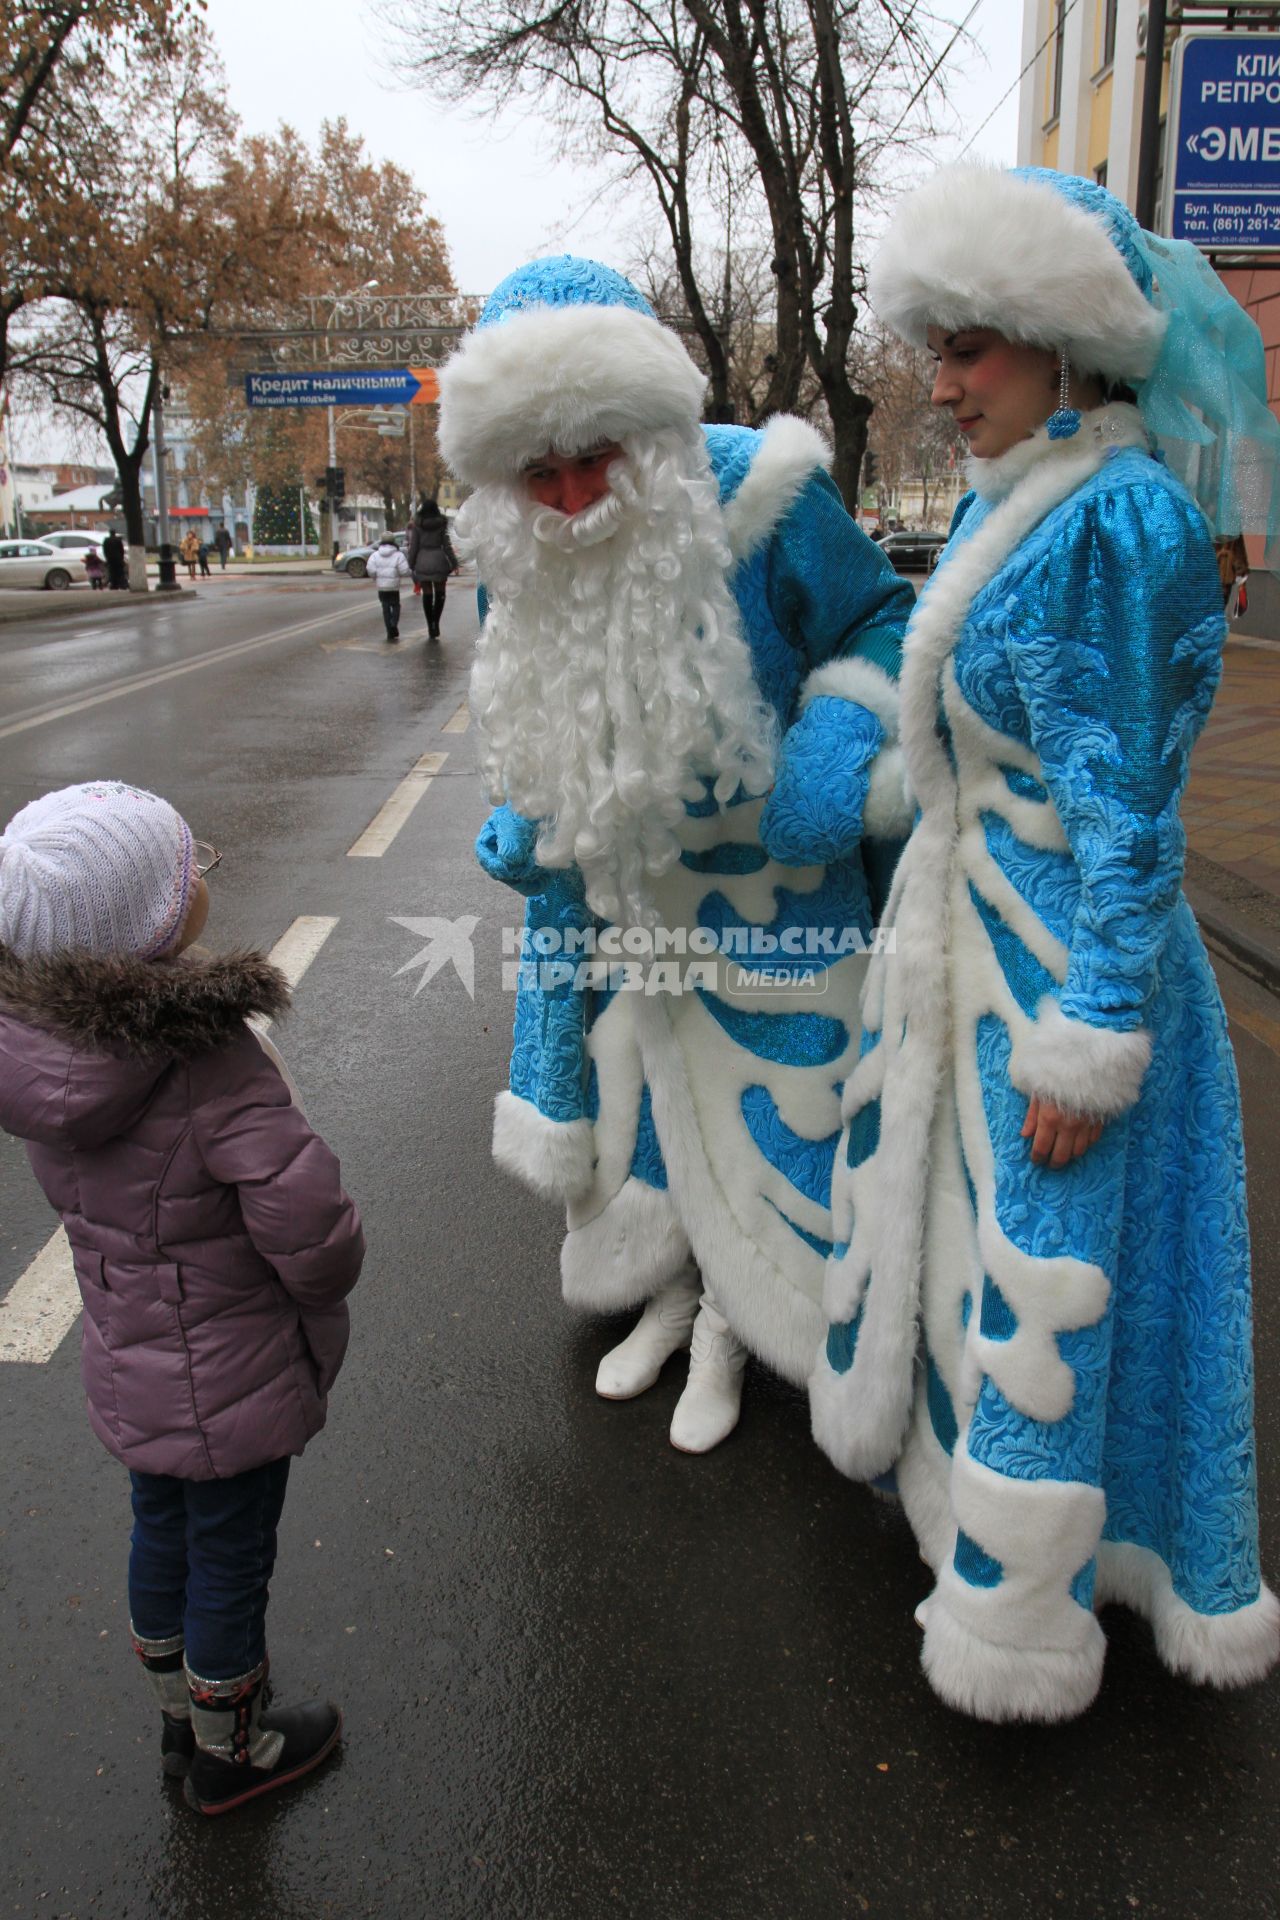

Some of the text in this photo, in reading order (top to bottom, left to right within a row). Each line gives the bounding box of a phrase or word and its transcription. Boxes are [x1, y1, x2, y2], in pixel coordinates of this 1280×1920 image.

[1237, 54, 1280, 77] КЛИ
[1201, 81, 1280, 103] РЕПРО
[1184, 203, 1210, 217] Бул.
[1213, 203, 1251, 217] Клары
[1184, 217, 1280, 233] тел. (861) 261-2
[251, 376, 406, 395] Кредит наличными
[287, 396, 298, 404] на
